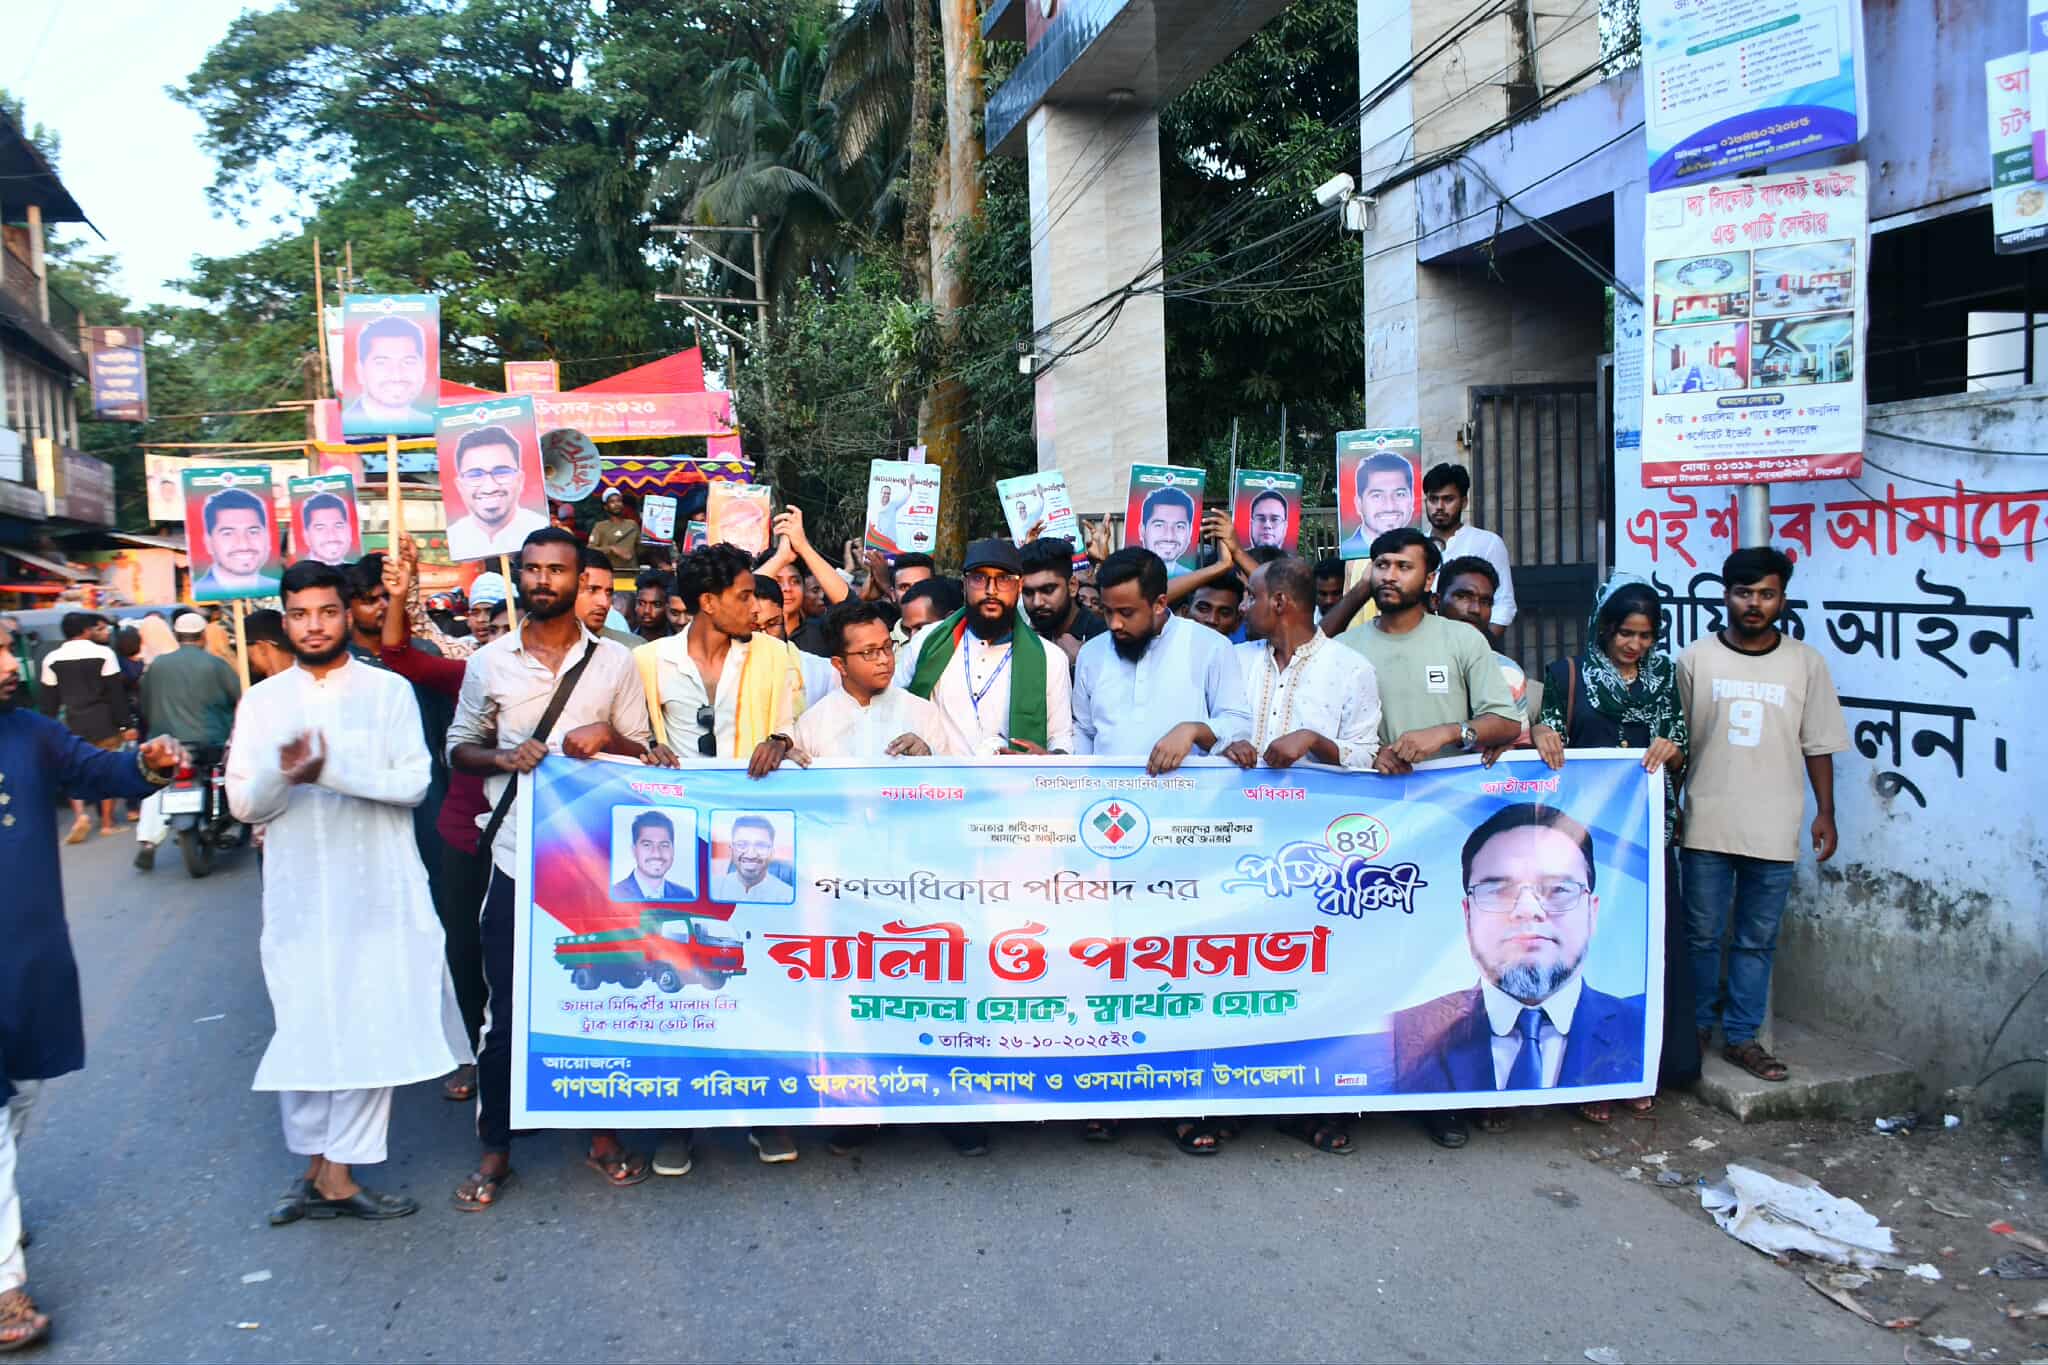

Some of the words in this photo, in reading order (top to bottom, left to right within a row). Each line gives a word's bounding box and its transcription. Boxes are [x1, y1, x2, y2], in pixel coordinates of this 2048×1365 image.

[1626, 487, 1697, 568] এই
[1705, 494, 1815, 564] শর
[1824, 479, 2048, 563] আমাদে
[1823, 568, 2035, 679] আইন
[1711, 678, 1787, 707] FOREVER
[1727, 701, 1764, 747] 9
[1838, 695, 1976, 809] লুন
[880, 783, 966, 801] ন্যায়বিচার
[1243, 784, 1307, 801] অধিকার
[1336, 823, 1380, 853] ৪র্থ
[815, 870, 1012, 905] গণঅধিকার
[1023, 870, 1137, 905] পরিষদ
[1147, 879, 1201, 902] এর
[1069, 924, 1334, 982] পথসভা
[848, 994, 969, 1022] সফল
[976, 994, 1078, 1026] হোক,
[1085, 982, 1205, 1024] স্বার্থক
[1213, 989, 1299, 1019] হোক
[659, 1017, 688, 1033] ভোট
[693, 1014, 717, 1030] দিন
[551, 1071, 681, 1100] গণঅধিকার
[691, 1069, 770, 1097] পরিষদ
[779, 1075, 798, 1096] ও
[949, 1066, 1037, 1093] বিশ্বনাথ
[1044, 1072, 1063, 1091] ও
[1073, 1063, 1205, 1092] ওসমানীনগর
[1211, 1062, 1307, 1088] উপজেলা
